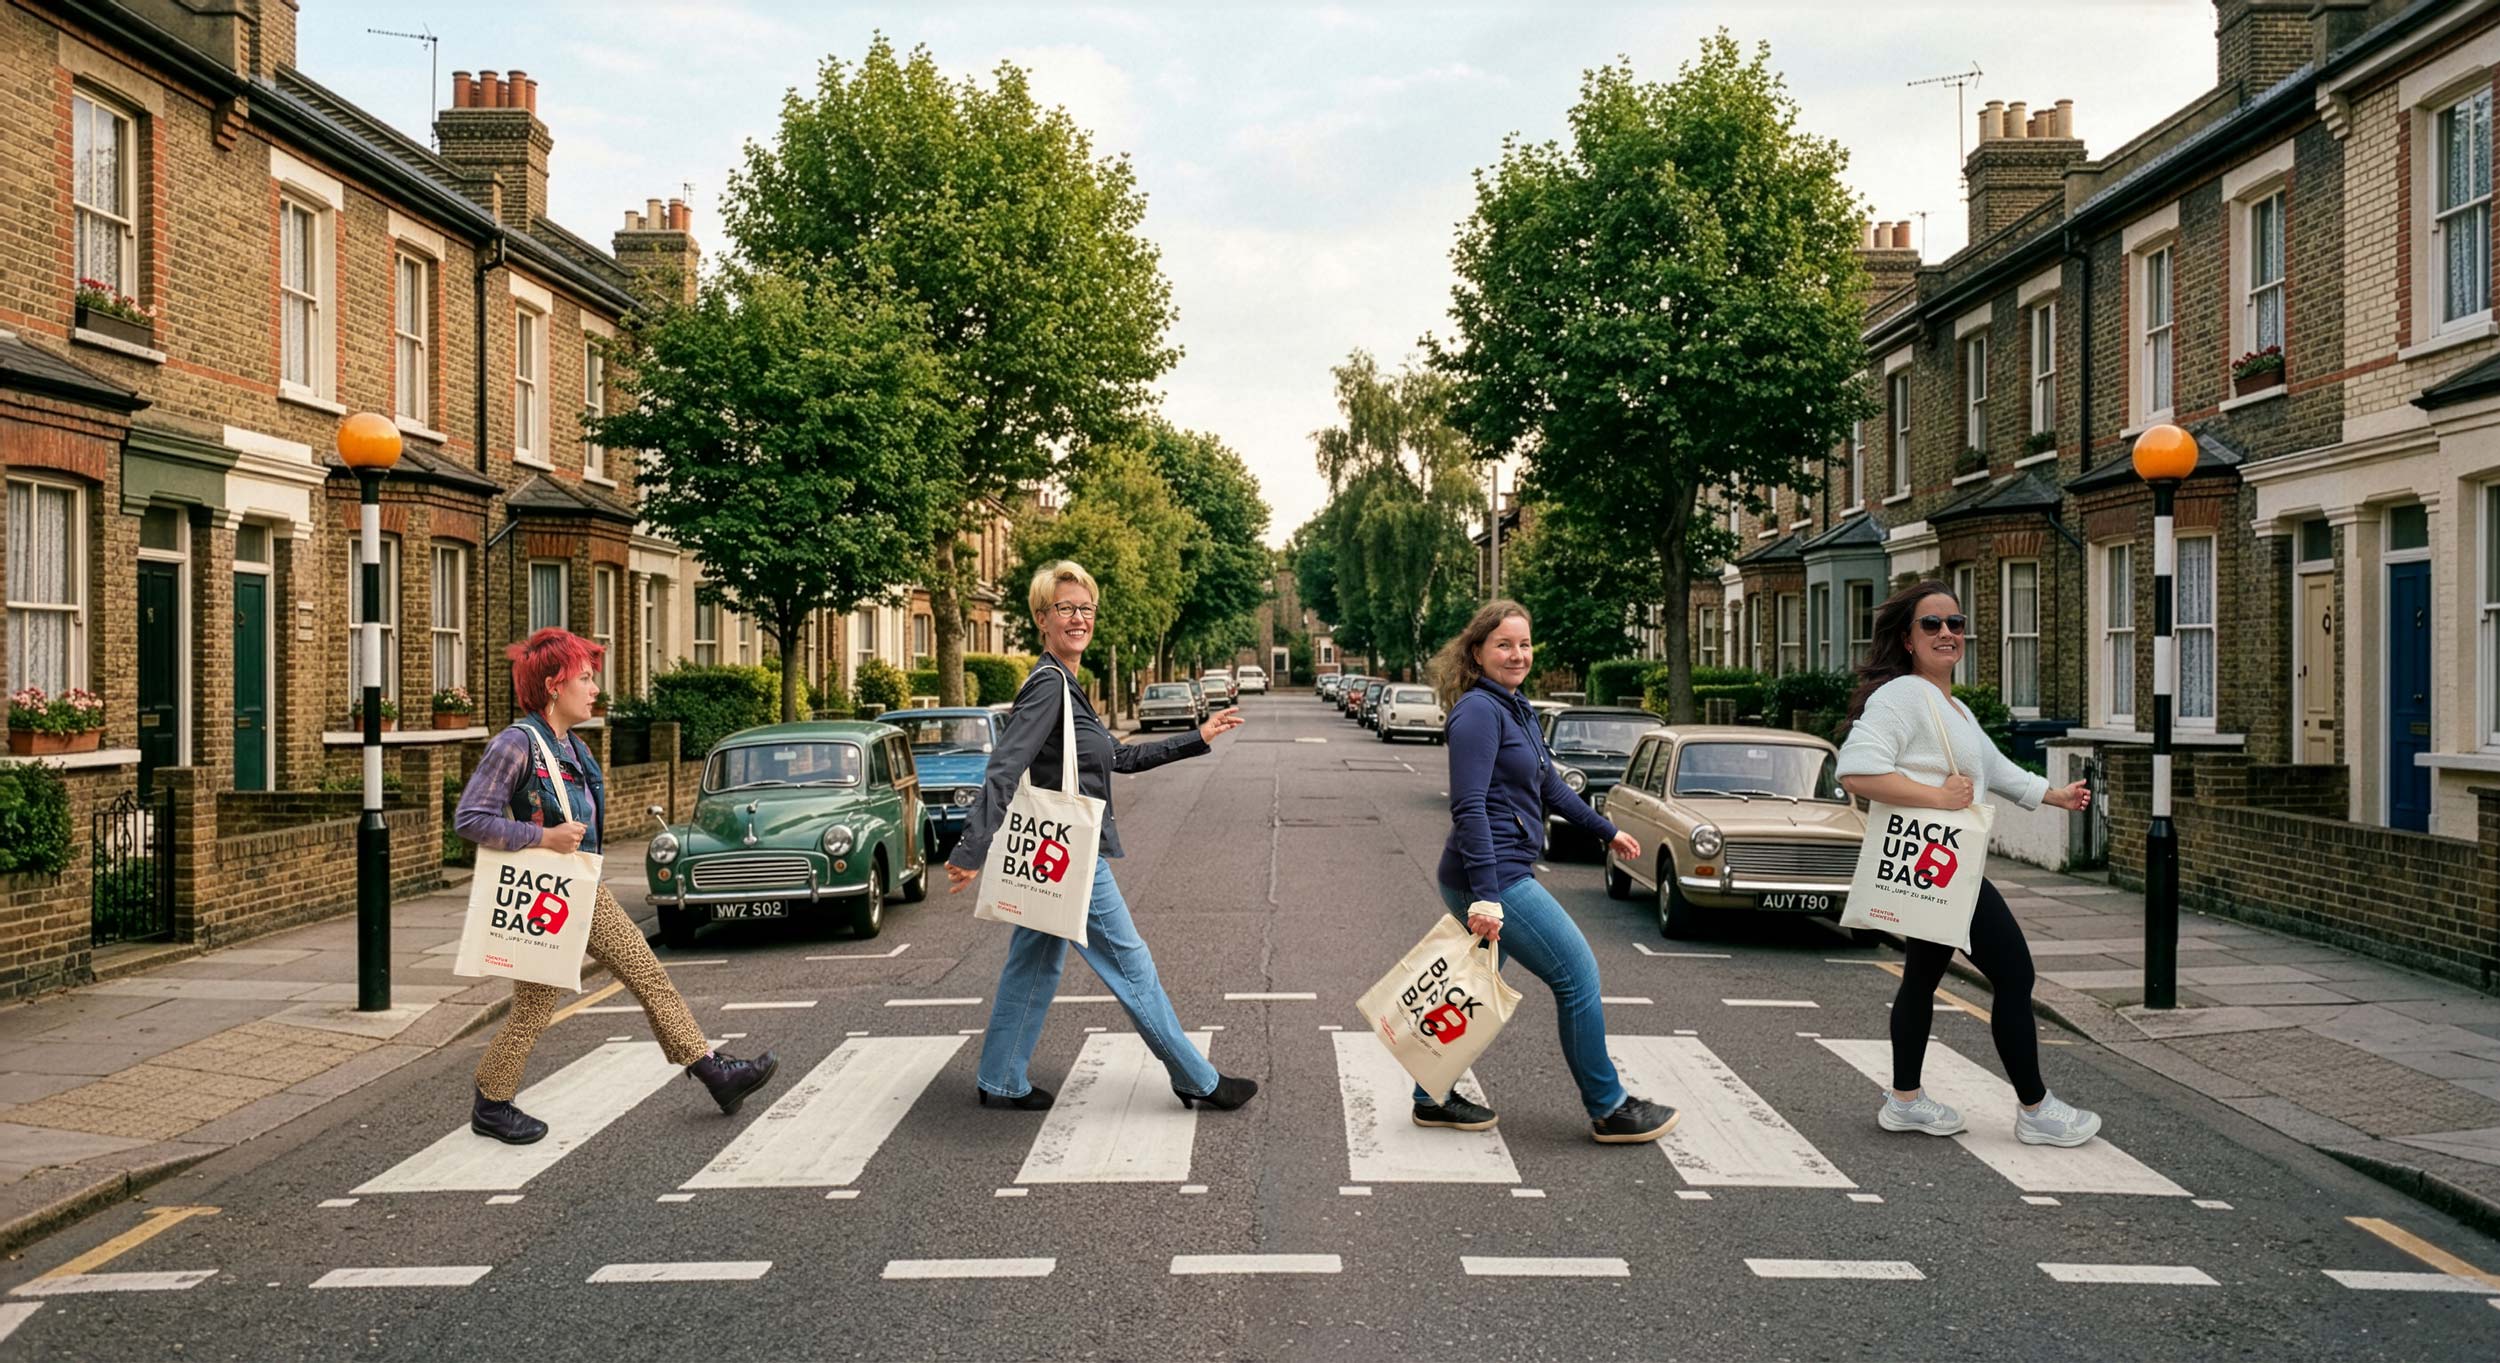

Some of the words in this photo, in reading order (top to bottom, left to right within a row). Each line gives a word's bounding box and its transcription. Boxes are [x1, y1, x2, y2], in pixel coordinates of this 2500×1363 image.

[1009, 812, 1072, 845] BACK
[1887, 814, 1962, 849] BACK
[1007, 834, 1036, 857] UP
[1883, 836, 1919, 861] UP
[499, 864, 573, 897] BACK
[1003, 855, 1049, 883] BAG
[1877, 859, 1933, 890] BAG
[496, 887, 532, 911] UP
[1763, 894, 1795, 909] AUY
[1875, 883, 1891, 891] WEIL
[491, 908, 546, 936] BAG
[1417, 971, 1440, 1006] UP
[1430, 957, 1483, 1019] BACK
[1401, 985, 1440, 1037] BAG
